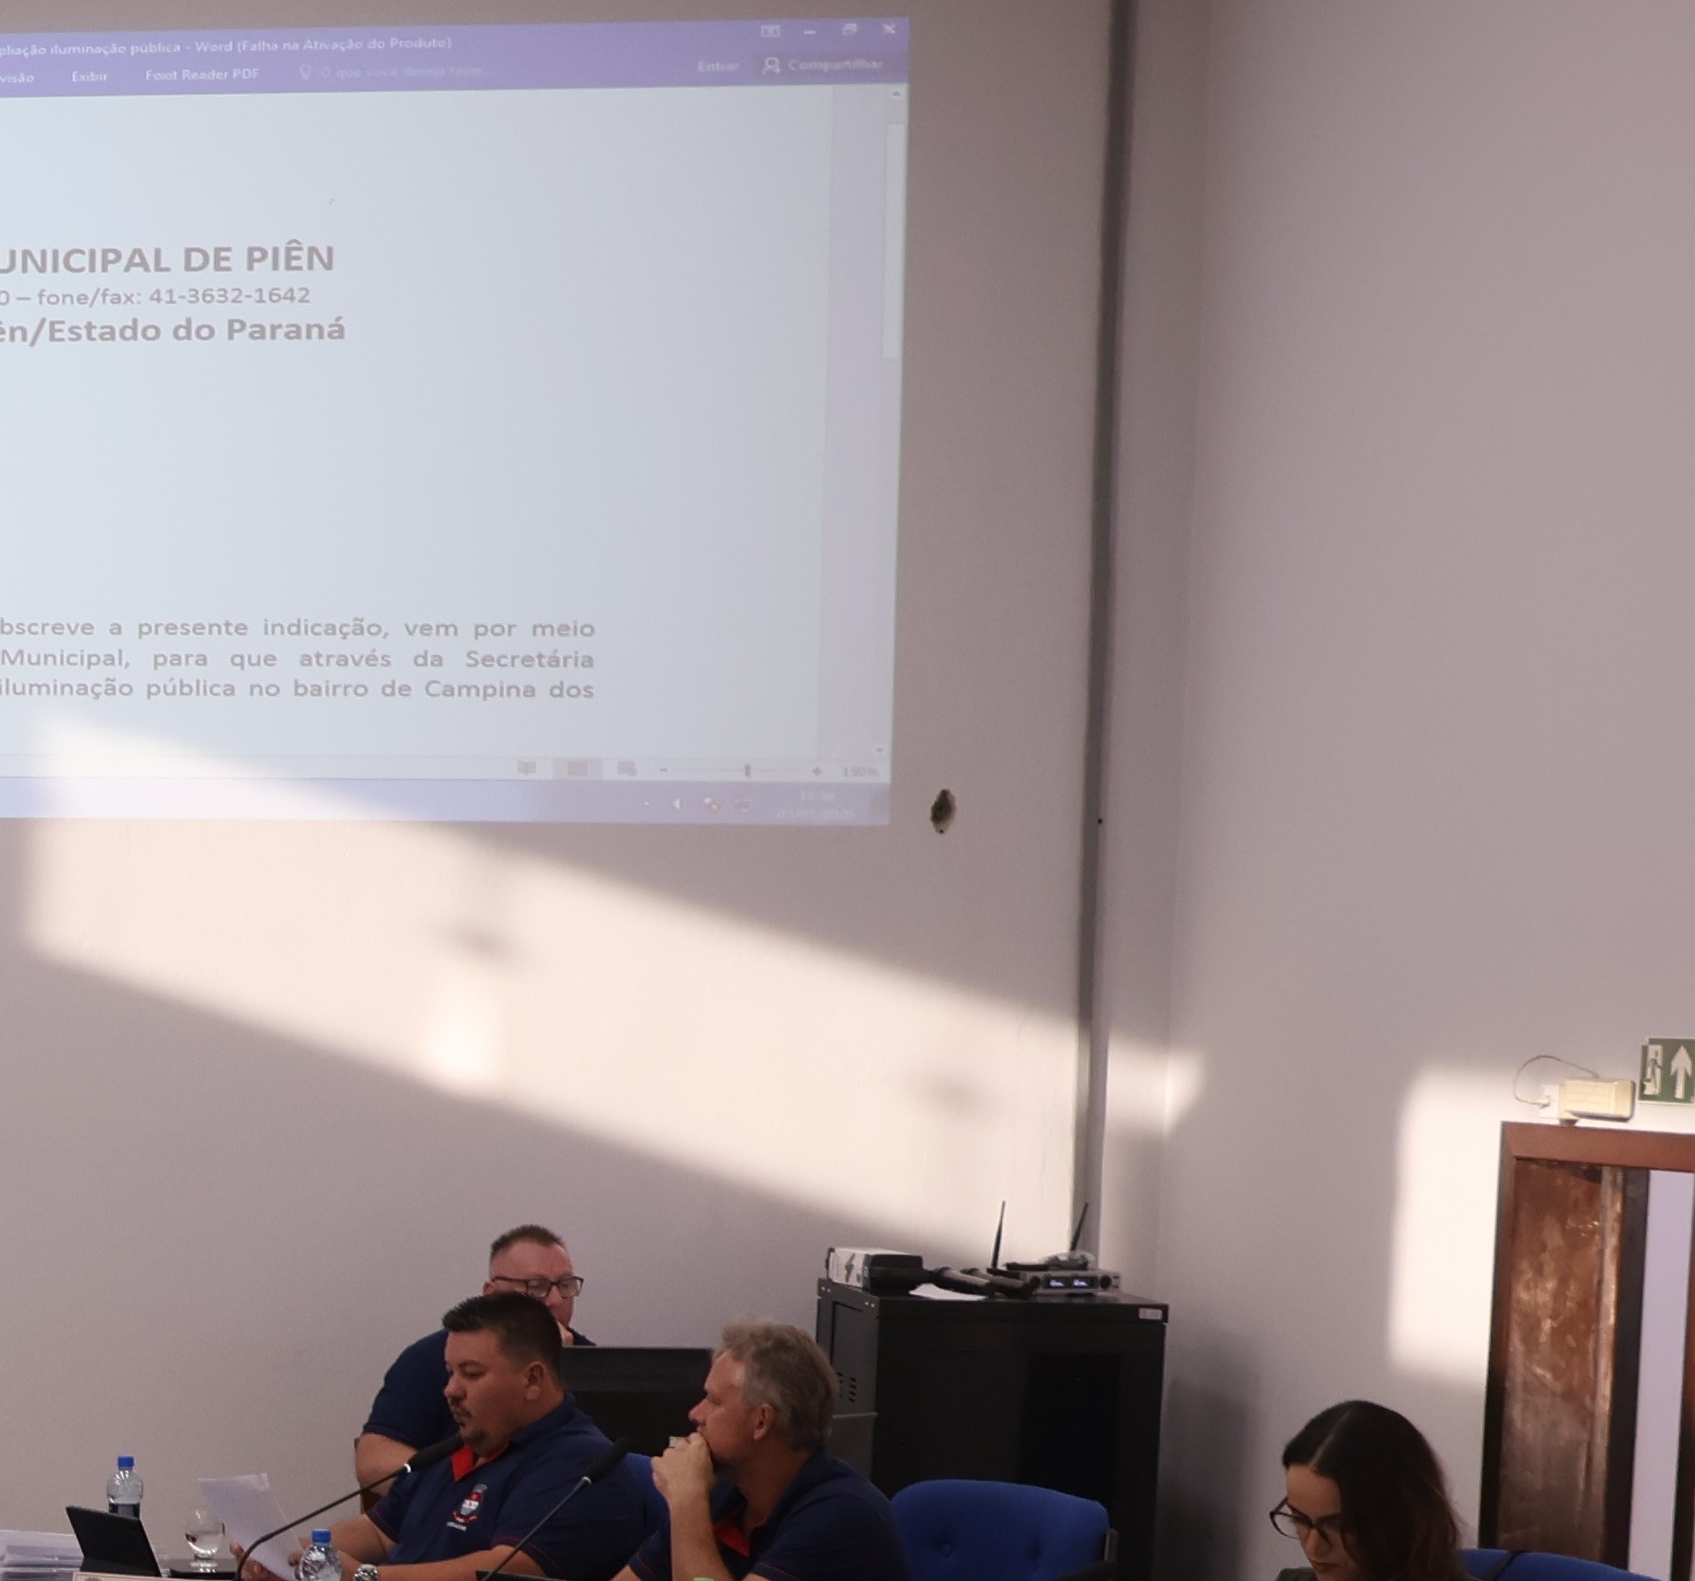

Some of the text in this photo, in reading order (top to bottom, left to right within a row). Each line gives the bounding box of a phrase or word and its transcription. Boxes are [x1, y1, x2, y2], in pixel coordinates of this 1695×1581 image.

[51, 44, 126, 58] iluminação
[130, 42, 181, 57] pública
[195, 40, 233, 53] Word
[237, 40, 279, 54] (Falha
[283, 42, 300, 51] na
[303, 38, 364, 53] Ativação
[367, 38, 386, 50] do
[390, 37, 452, 50] Produto)
[72, 70, 109, 82] Exibir
[182, 68, 228, 80] Reader
[233, 67, 260, 80] PDF
[183, 246, 232, 273] DE
[246, 239, 334, 273] PIÊN
[38, 286, 142, 309] fone/fax:
[149, 287, 311, 305] 41-3632-1642
[172, 317, 216, 342] do
[227, 315, 346, 342] Paraná
[108, 622, 123, 636] a
[138, 619, 248, 640] presente
[263, 617, 390, 640] indicação,
[404, 622, 459, 637] vem
[474, 622, 517, 641] por
[532, 618, 596, 637] meio
[0, 648, 131, 670] Municipal,
[153, 652, 209, 670] para
[230, 652, 278, 671] que
[299, 648, 392, 668] através
[413, 649, 443, 668] da
[465, 648, 595, 669] Secretária
[146, 677, 236, 701] pública
[249, 682, 281, 698] no
[293, 679, 369, 698] bairro
[380, 679, 412, 698] de
[425, 680, 536, 703] Campina
[549, 679, 595, 699] dos
